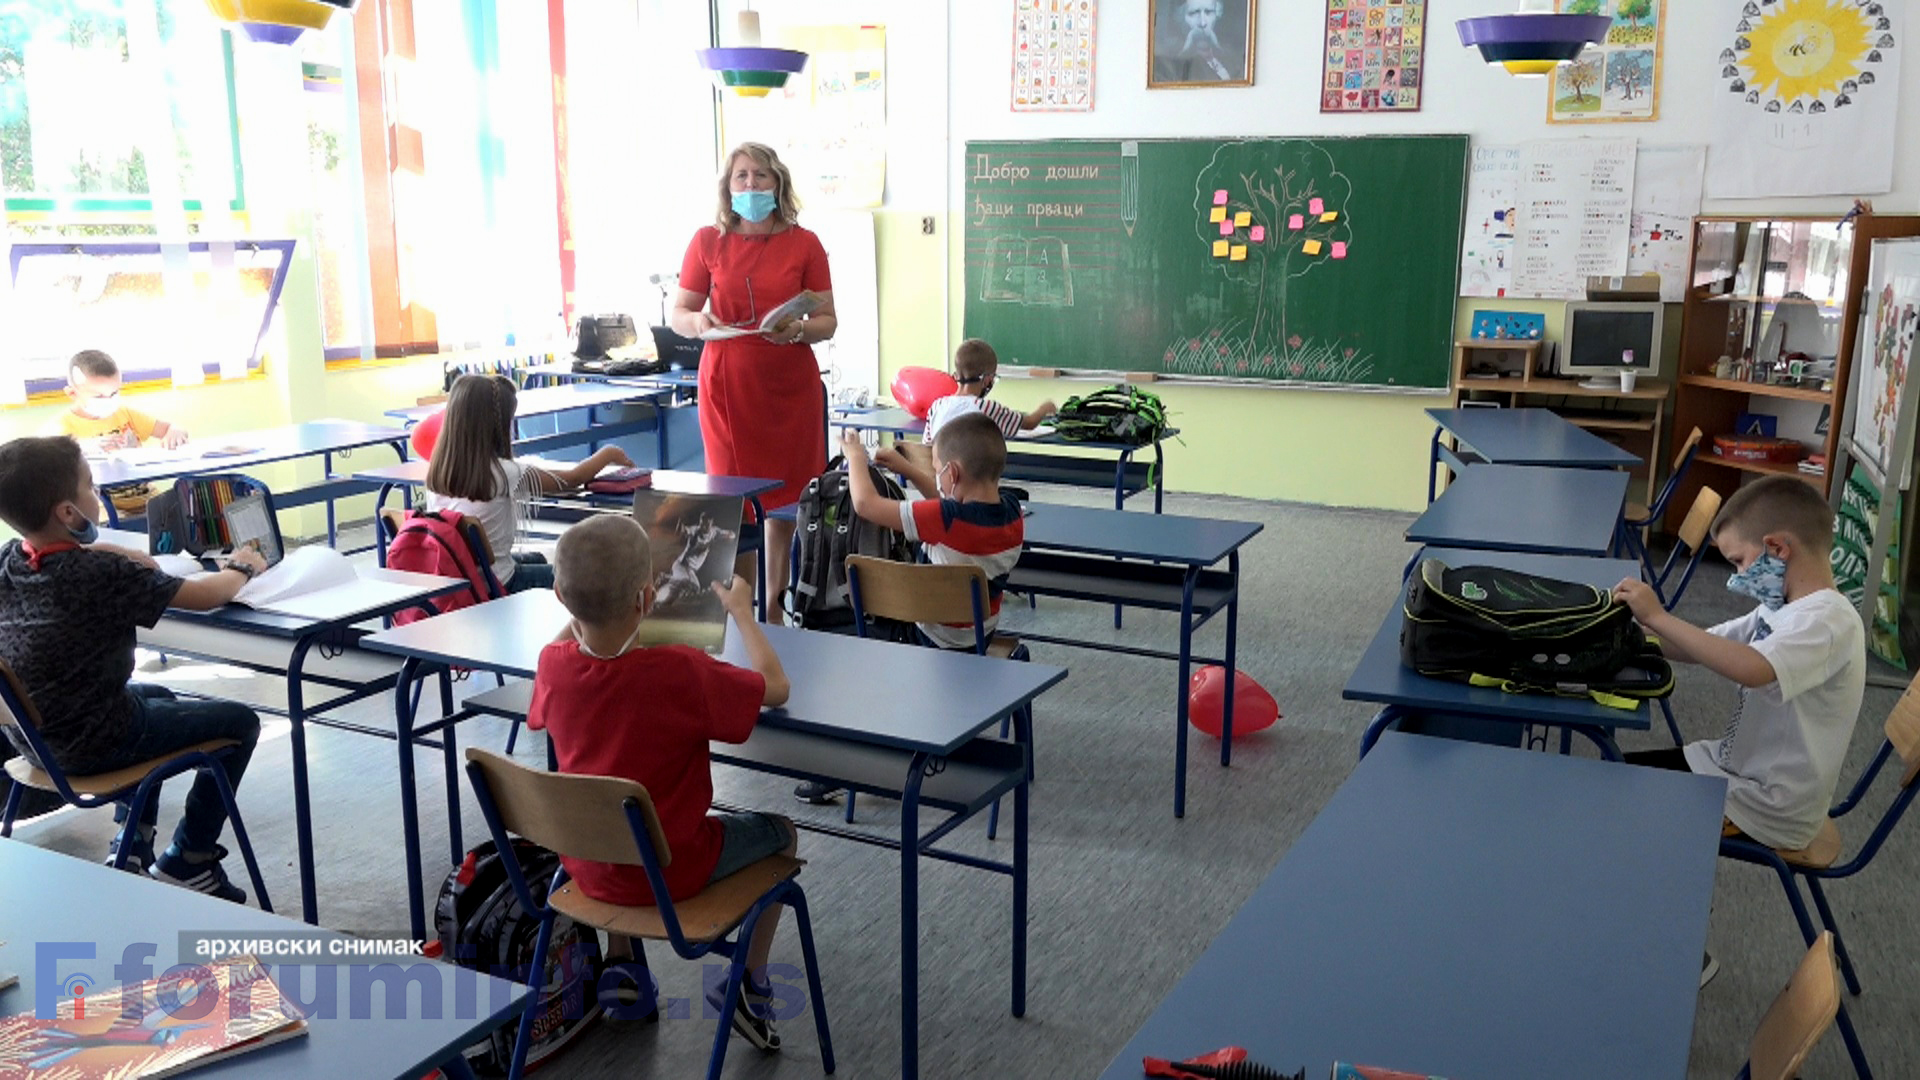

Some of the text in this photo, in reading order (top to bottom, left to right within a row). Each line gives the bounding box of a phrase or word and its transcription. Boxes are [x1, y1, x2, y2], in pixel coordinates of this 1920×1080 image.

[974, 154, 1099, 186] Добро дошли
[1027, 203, 1084, 227] прваци
